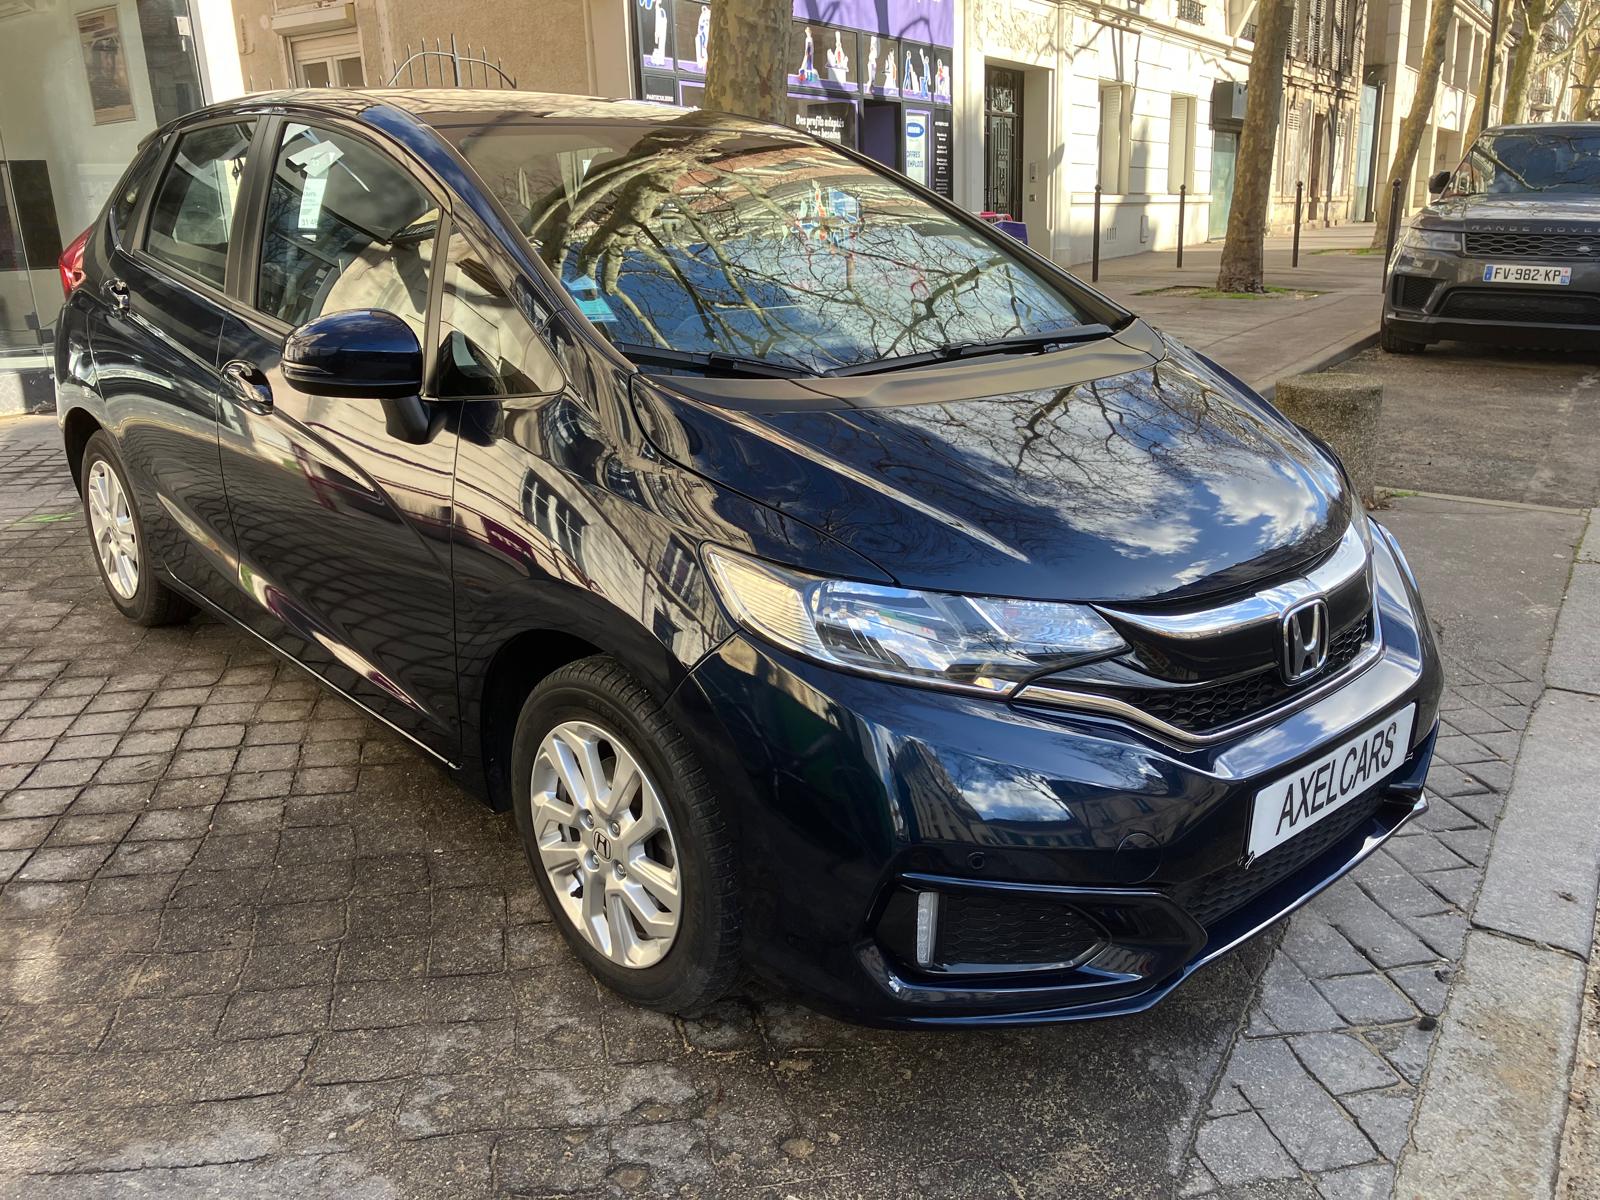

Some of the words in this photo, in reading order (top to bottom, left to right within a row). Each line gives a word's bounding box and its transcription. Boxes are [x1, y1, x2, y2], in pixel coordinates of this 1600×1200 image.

[796, 114, 806, 125] Des
[806, 115, 824, 129] profils
[821, 128, 841, 139] besoins
[1275, 721, 1397, 836] AXELCARS
